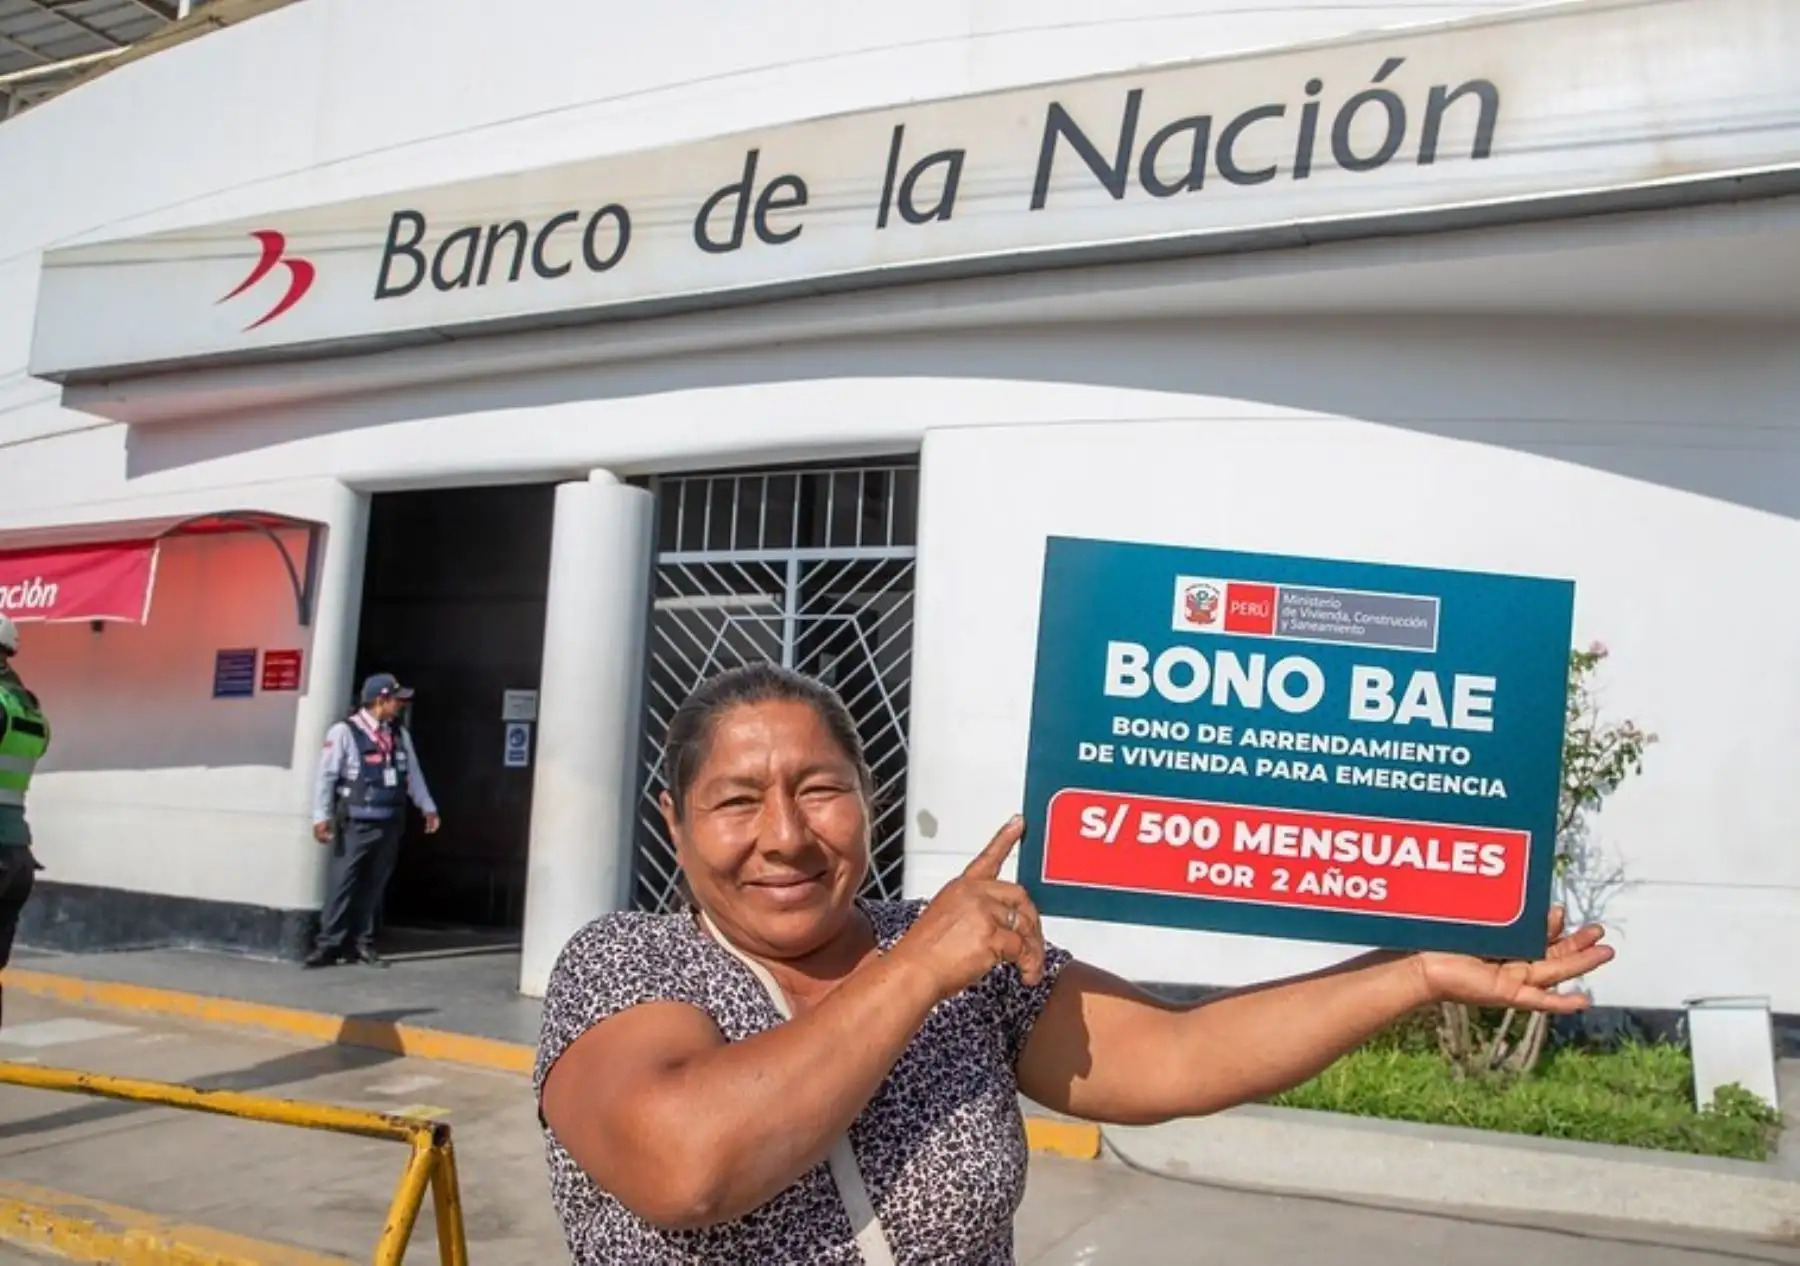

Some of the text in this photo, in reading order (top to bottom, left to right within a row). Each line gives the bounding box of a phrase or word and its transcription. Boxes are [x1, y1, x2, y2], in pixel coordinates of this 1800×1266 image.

[373, 57, 1502, 300] Banco de la Nación
[1230, 600, 1269, 617] PERÚ
[1281, 607, 1428, 629] de Vivienda, Construcción
[1283, 592, 1342, 609] Ministerio
[1280, 620, 1366, 637] y Saneamiento
[1103, 640, 1497, 732] BONO BAE
[1112, 716, 1471, 766] BONO DE ARRENDAMIENTO
[1078, 742, 1507, 798] DE VIVIENDA PARA EMERGENCIA
[1080, 803, 1506, 876] S/ 500 MENSUALES
[1187, 859, 1388, 901] POR 2 AÑOS
